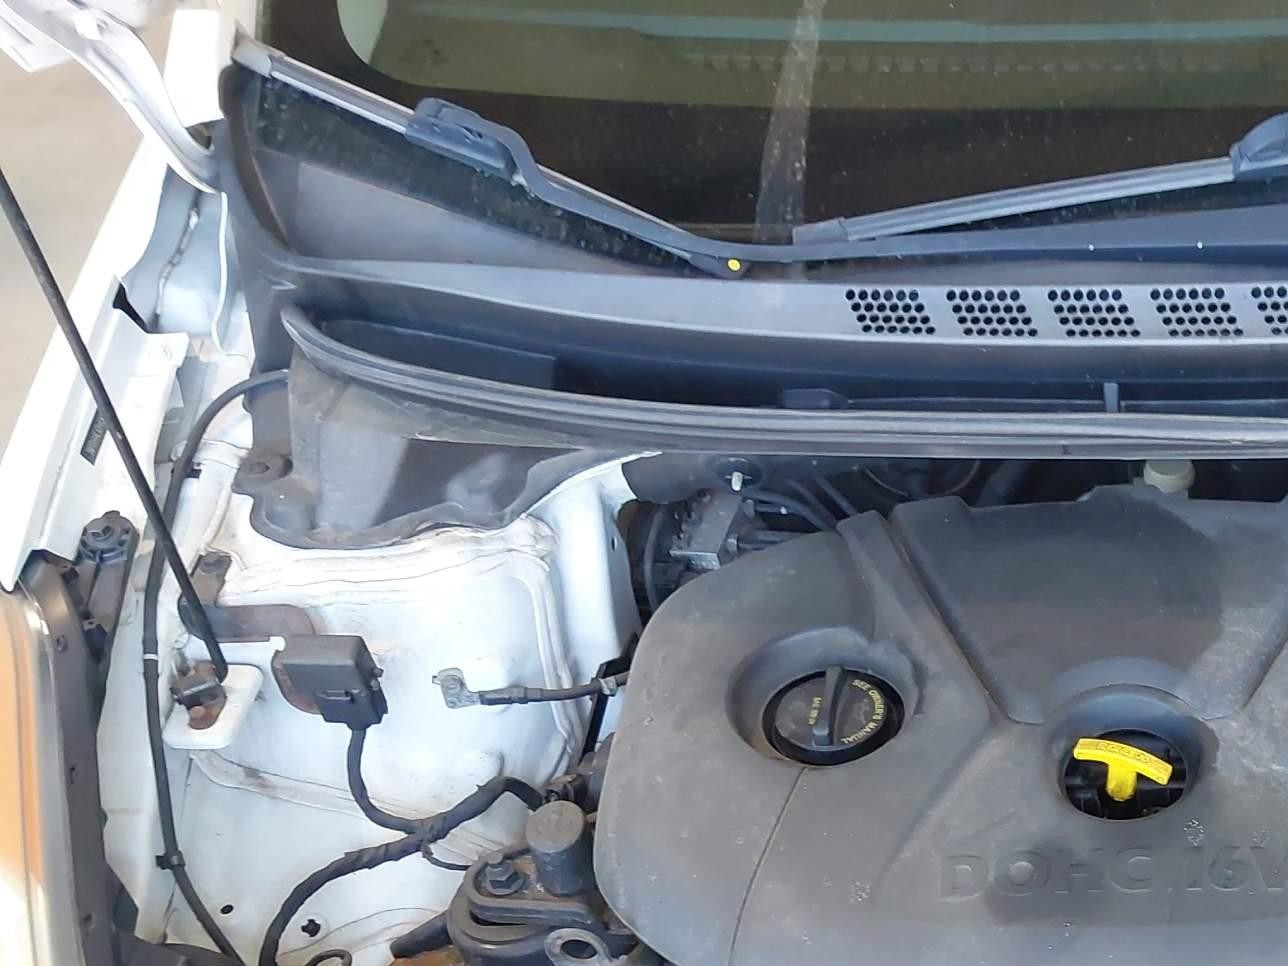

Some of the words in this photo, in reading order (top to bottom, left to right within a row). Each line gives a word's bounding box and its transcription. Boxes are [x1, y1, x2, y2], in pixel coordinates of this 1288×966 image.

[851, 679, 872, 692] SEE
[839, 721, 879, 744] MANUAL
[939, 846, 1154, 902] DOHC
